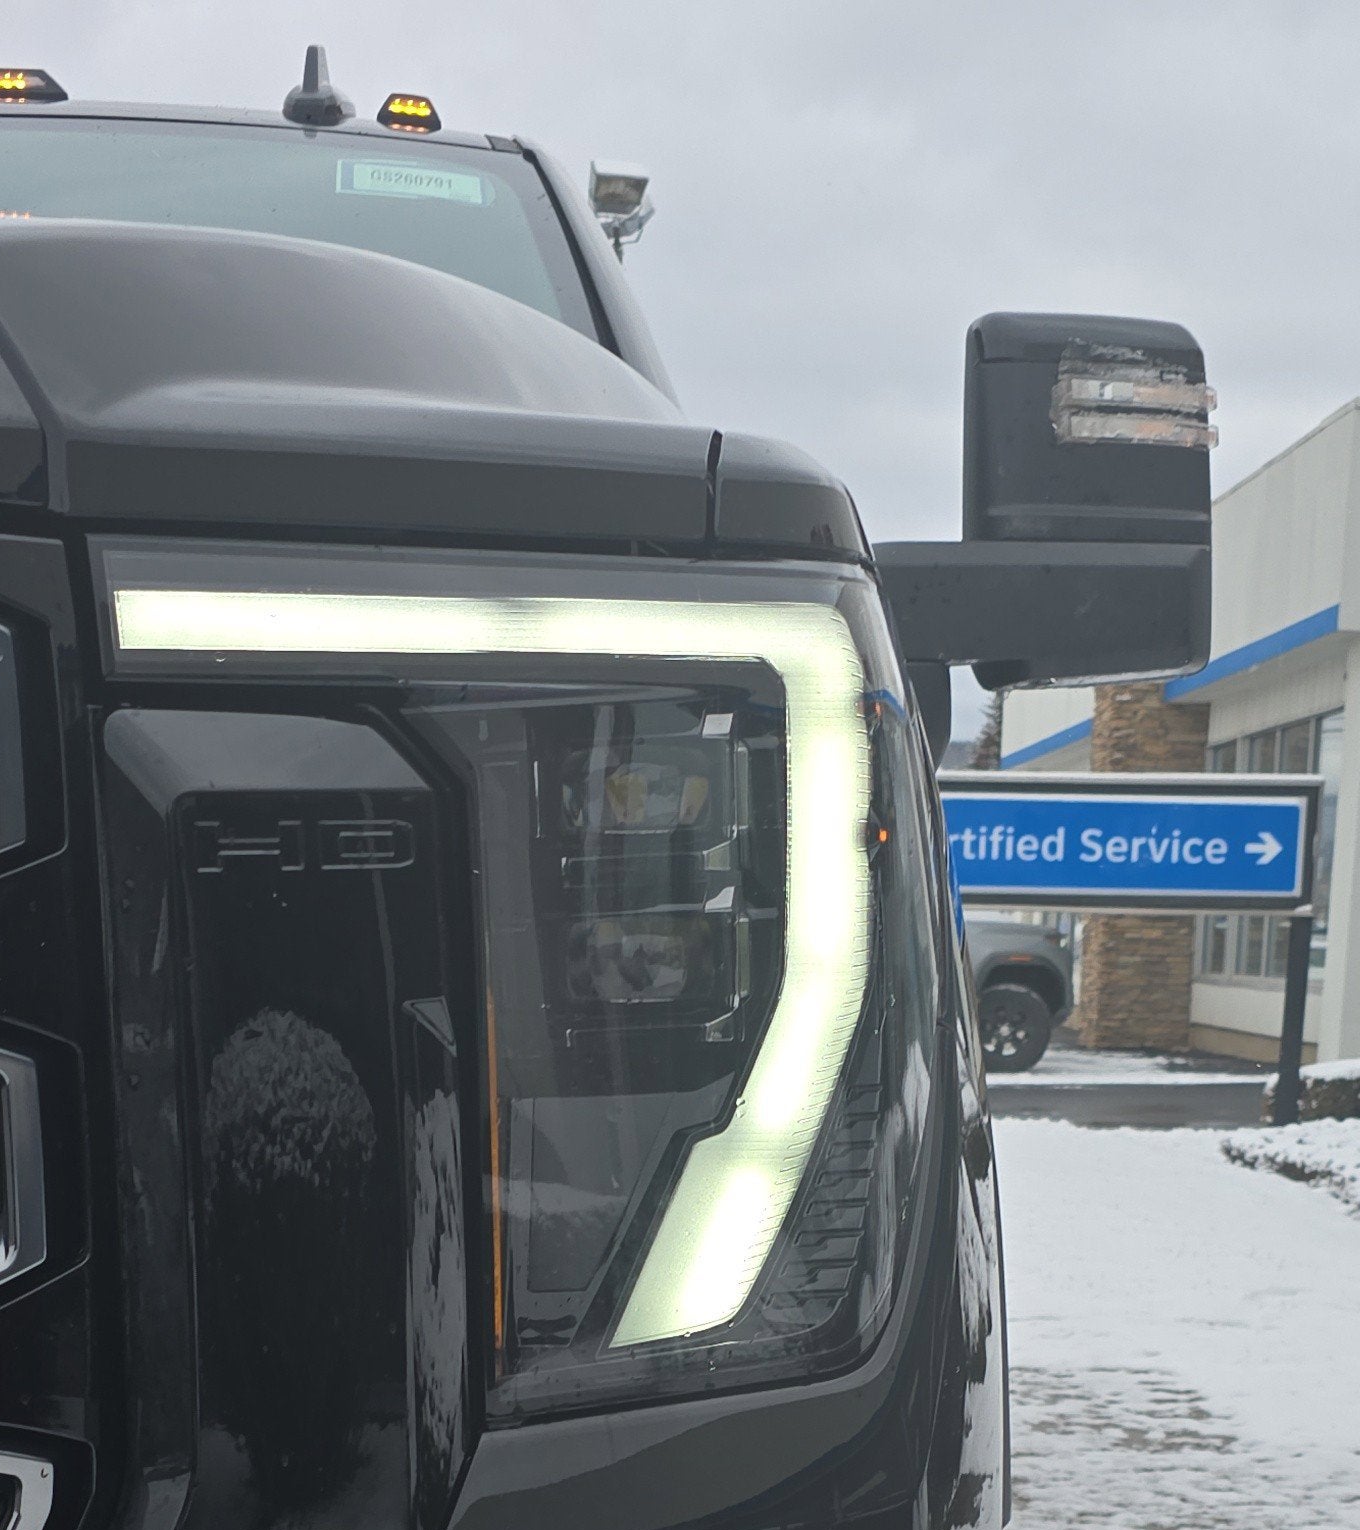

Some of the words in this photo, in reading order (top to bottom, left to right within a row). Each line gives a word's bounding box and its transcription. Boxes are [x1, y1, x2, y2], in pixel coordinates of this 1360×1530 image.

[193, 819, 416, 874] HD
[948, 825, 1065, 862] rtified
[1079, 827, 1228, 864] Service
